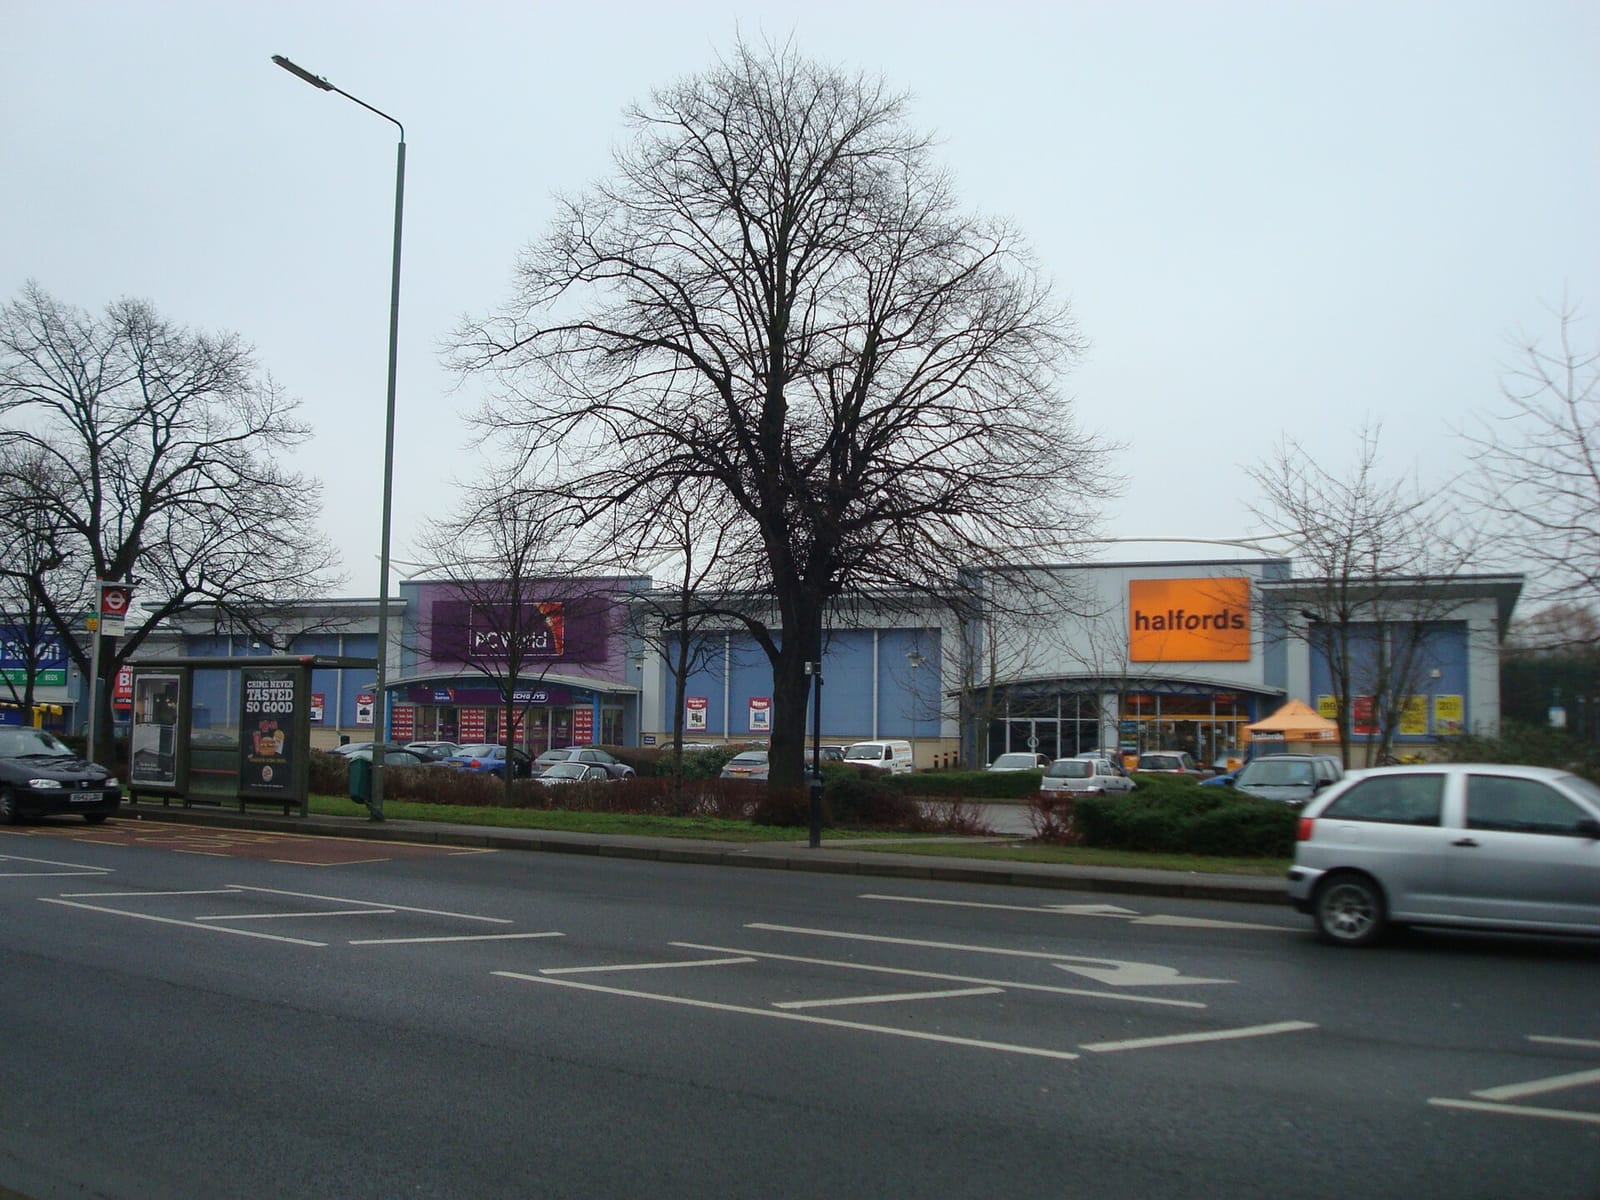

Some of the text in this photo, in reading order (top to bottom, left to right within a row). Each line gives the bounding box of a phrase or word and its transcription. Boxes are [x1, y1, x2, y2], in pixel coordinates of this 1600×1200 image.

[1135, 609, 1245, 631] halfords
[247, 680, 294, 688] CRIME NEVER
[247, 688, 294, 701] TASTED
[246, 701, 293, 713] SO GOOD
